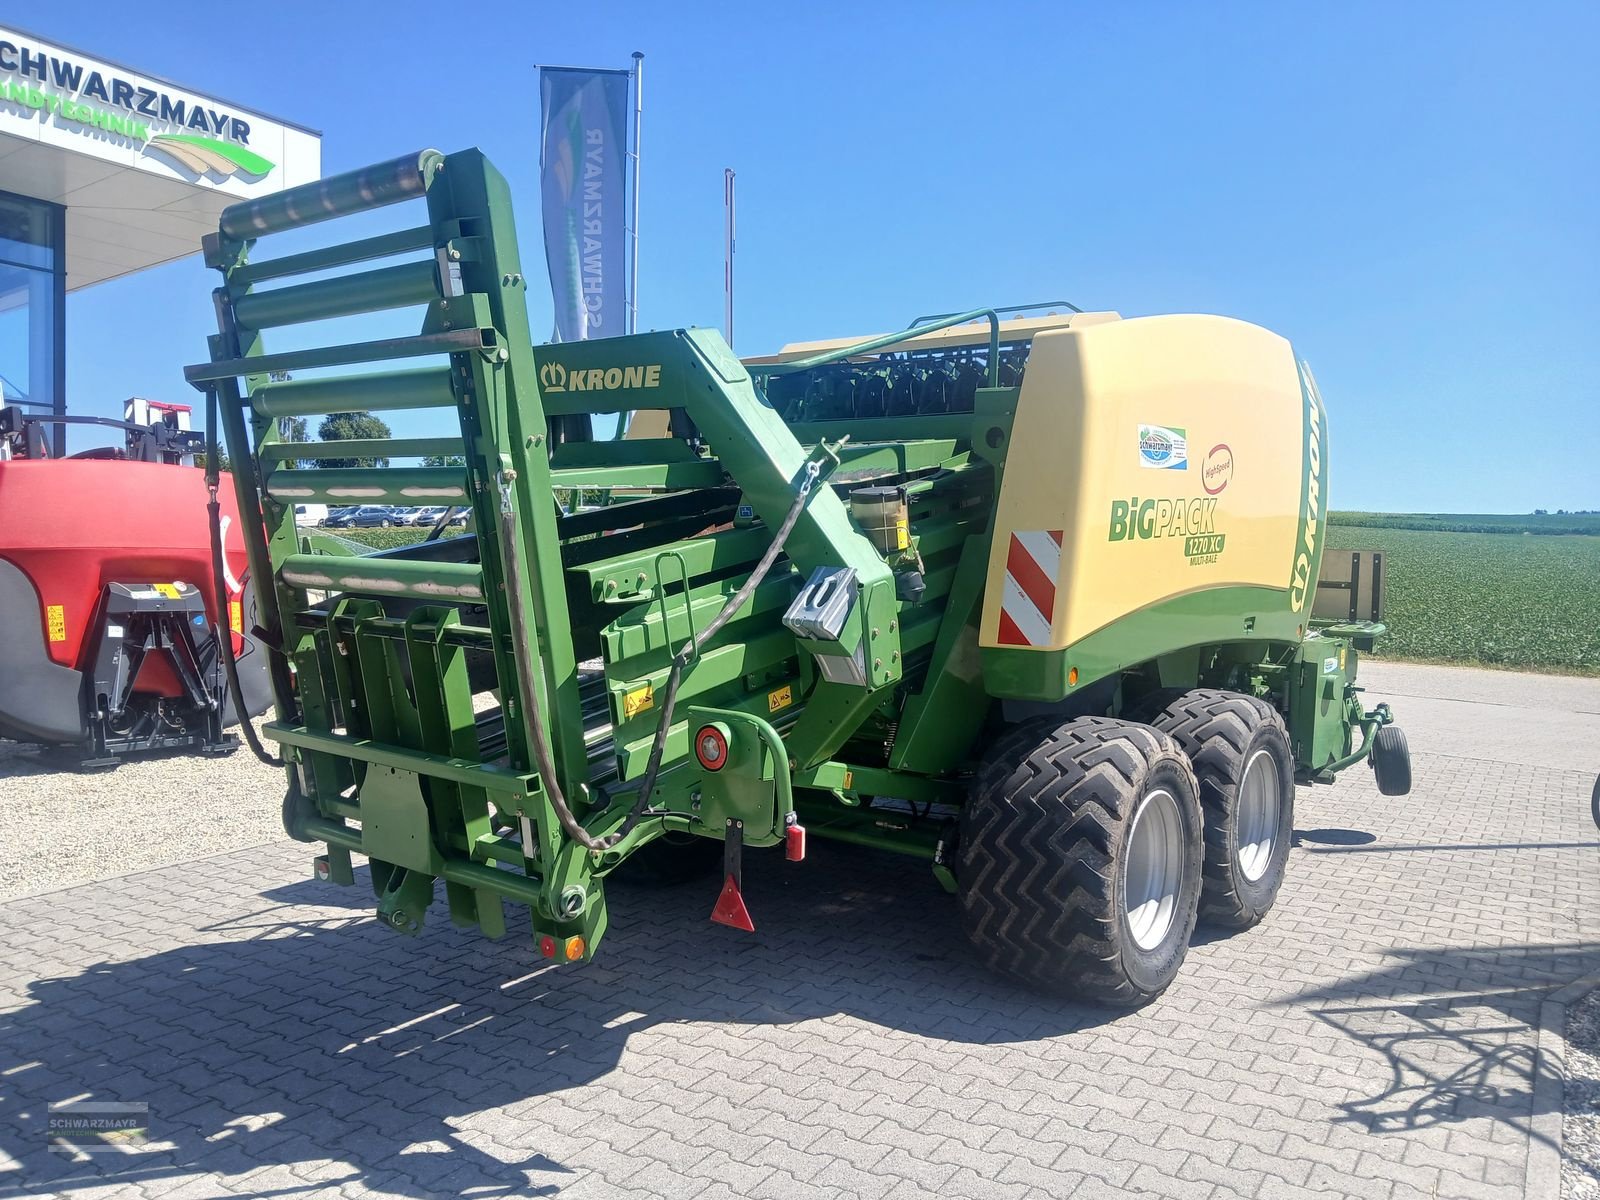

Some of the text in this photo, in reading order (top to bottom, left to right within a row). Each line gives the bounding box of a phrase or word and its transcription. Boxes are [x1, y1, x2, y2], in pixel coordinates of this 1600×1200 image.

[568, 364, 662, 391] KRONE
[1189, 535, 1222, 555] 1270 XC
